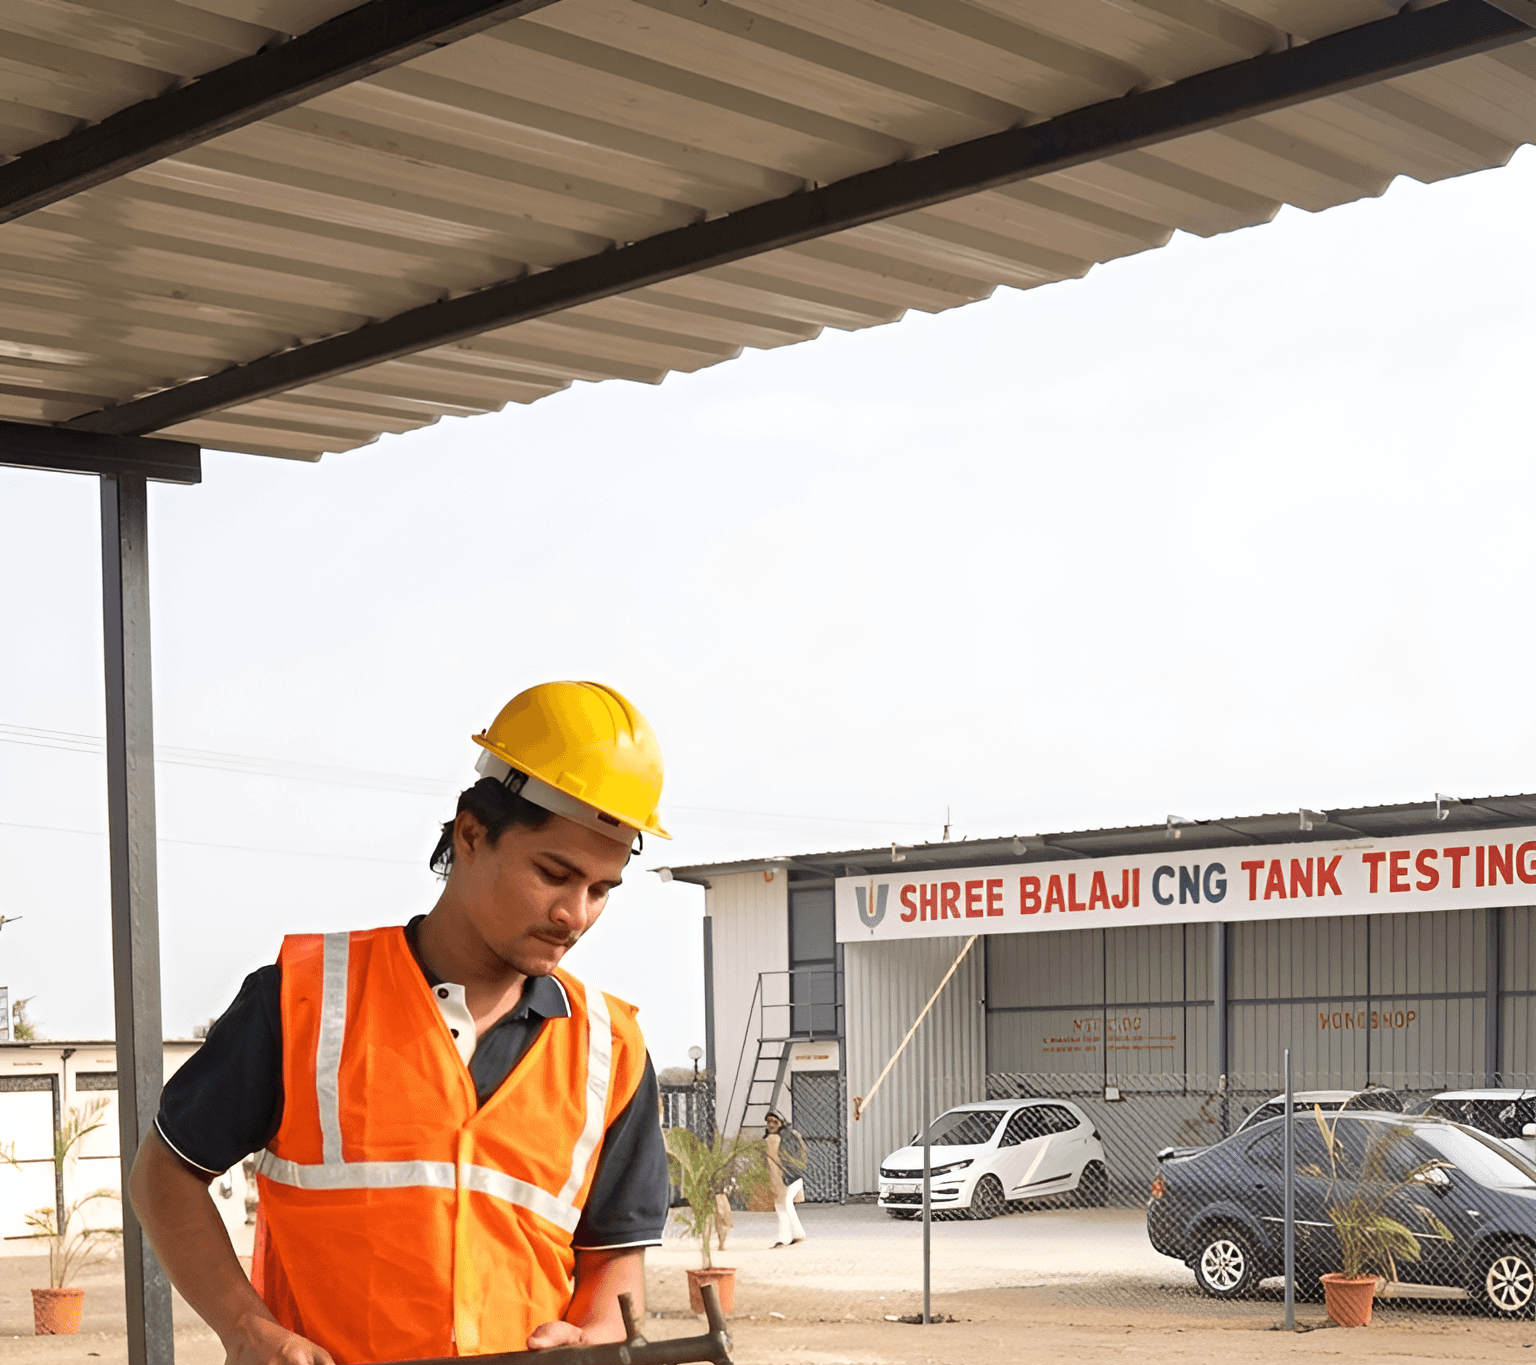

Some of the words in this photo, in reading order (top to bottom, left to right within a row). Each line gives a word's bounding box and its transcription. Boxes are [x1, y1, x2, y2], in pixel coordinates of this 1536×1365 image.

[900, 878, 1003, 922] SHREE
[1020, 868, 1140, 915] BALAJI
[1152, 862, 1227, 905] CNG
[1241, 855, 1343, 901] TANK
[1362, 840, 1536, 894] TESTING
